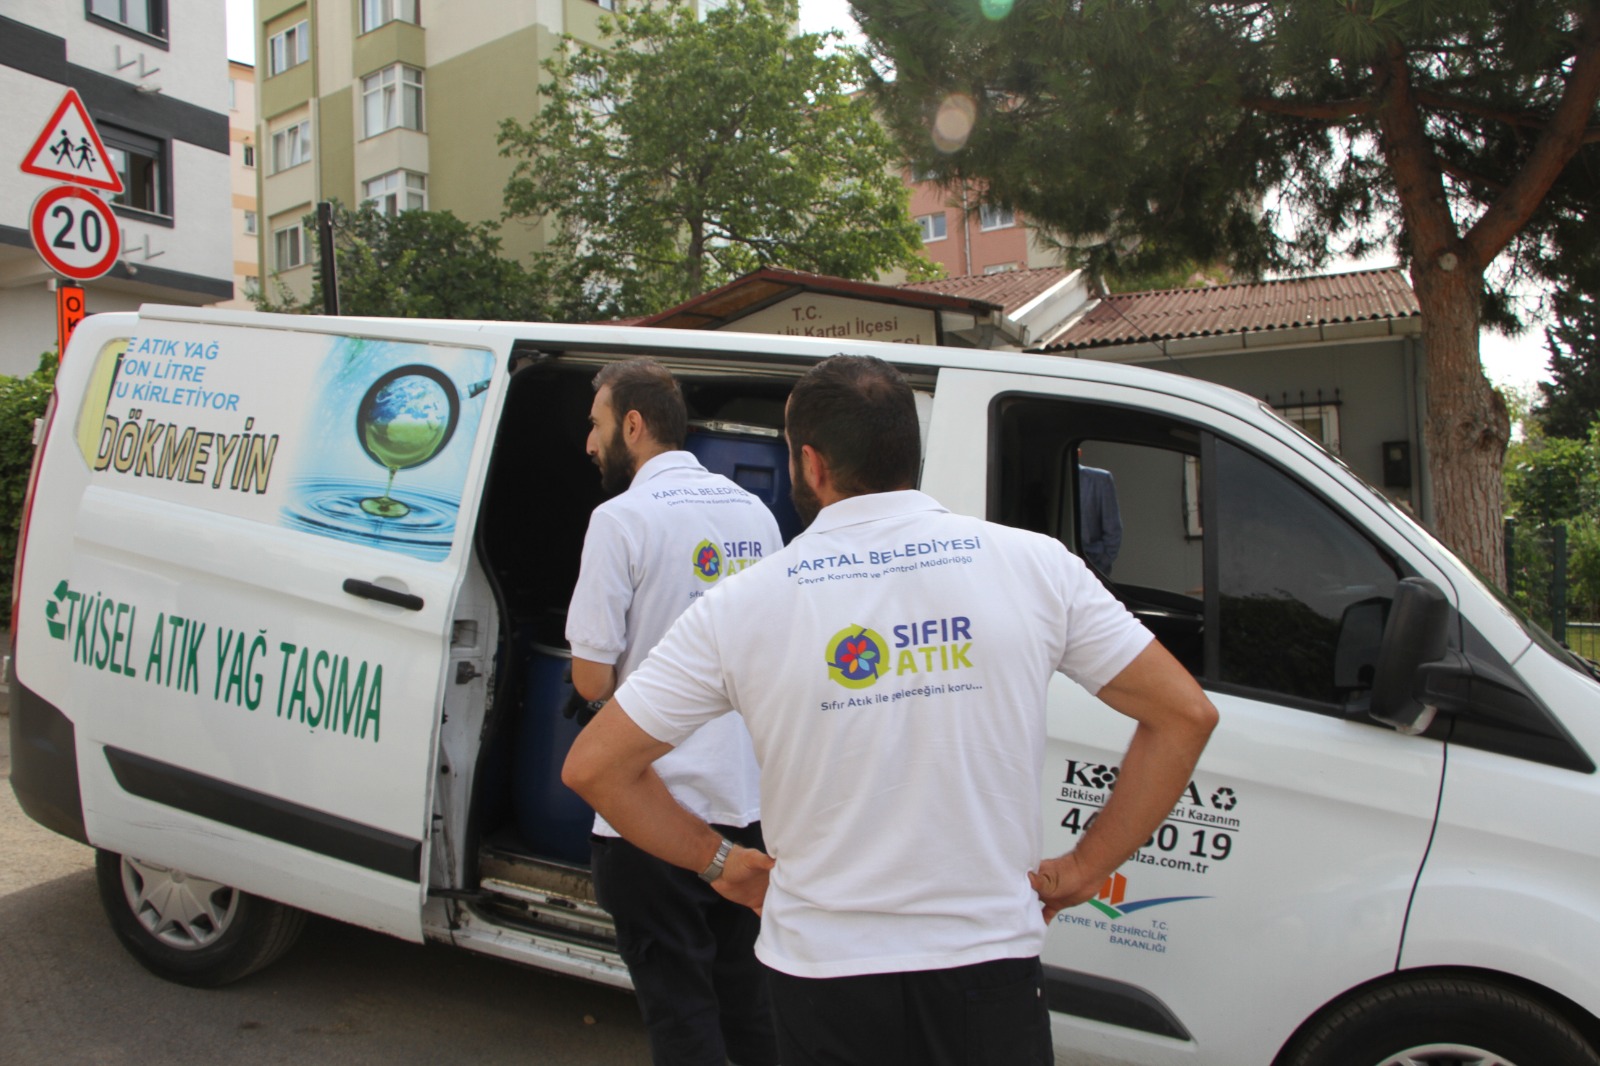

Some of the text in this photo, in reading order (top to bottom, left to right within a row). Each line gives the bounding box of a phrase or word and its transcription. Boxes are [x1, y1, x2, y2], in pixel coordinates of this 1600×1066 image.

[52, 205, 103, 253] 20
[792, 306, 822, 321] T.C.
[804, 322, 850, 338] Kartal
[856, 316, 898, 337] İlçesi
[139, 338, 180, 356] ATIK
[184, 341, 220, 360] YAĞ
[153, 361, 206, 382] LİTRE
[131, 381, 240, 411] KİRLETİYOR
[94, 408, 280, 495] DÖKMEYİN
[724, 541, 762, 557] SIFIR
[787, 536, 981, 577] KARTAL BELEDİYESİ
[797, 576, 825, 585] Çevre
[827, 572, 868, 581] Koruma
[920, 555, 973, 568] Müdürlüğü
[893, 616, 973, 648] SIFIR
[896, 642, 974, 676] ATIK
[145, 612, 206, 695] ATIK
[214, 626, 267, 711] YAĞ
[276, 642, 383, 742] TAŞIMA
[821, 698, 845, 711] Sıfır
[848, 695, 872, 708] Atık
[875, 693, 889, 704] ile
[1061, 787, 1240, 827] Bitkisel eri Kazanım
[1189, 829, 1232, 860] 19
[1057, 913, 1167, 942] ÇEVRE VE ŞEHİRCİLİK
[1151, 920, 1169, 930] T.C.
[1109, 935, 1166, 953] BAKANLIĞI
